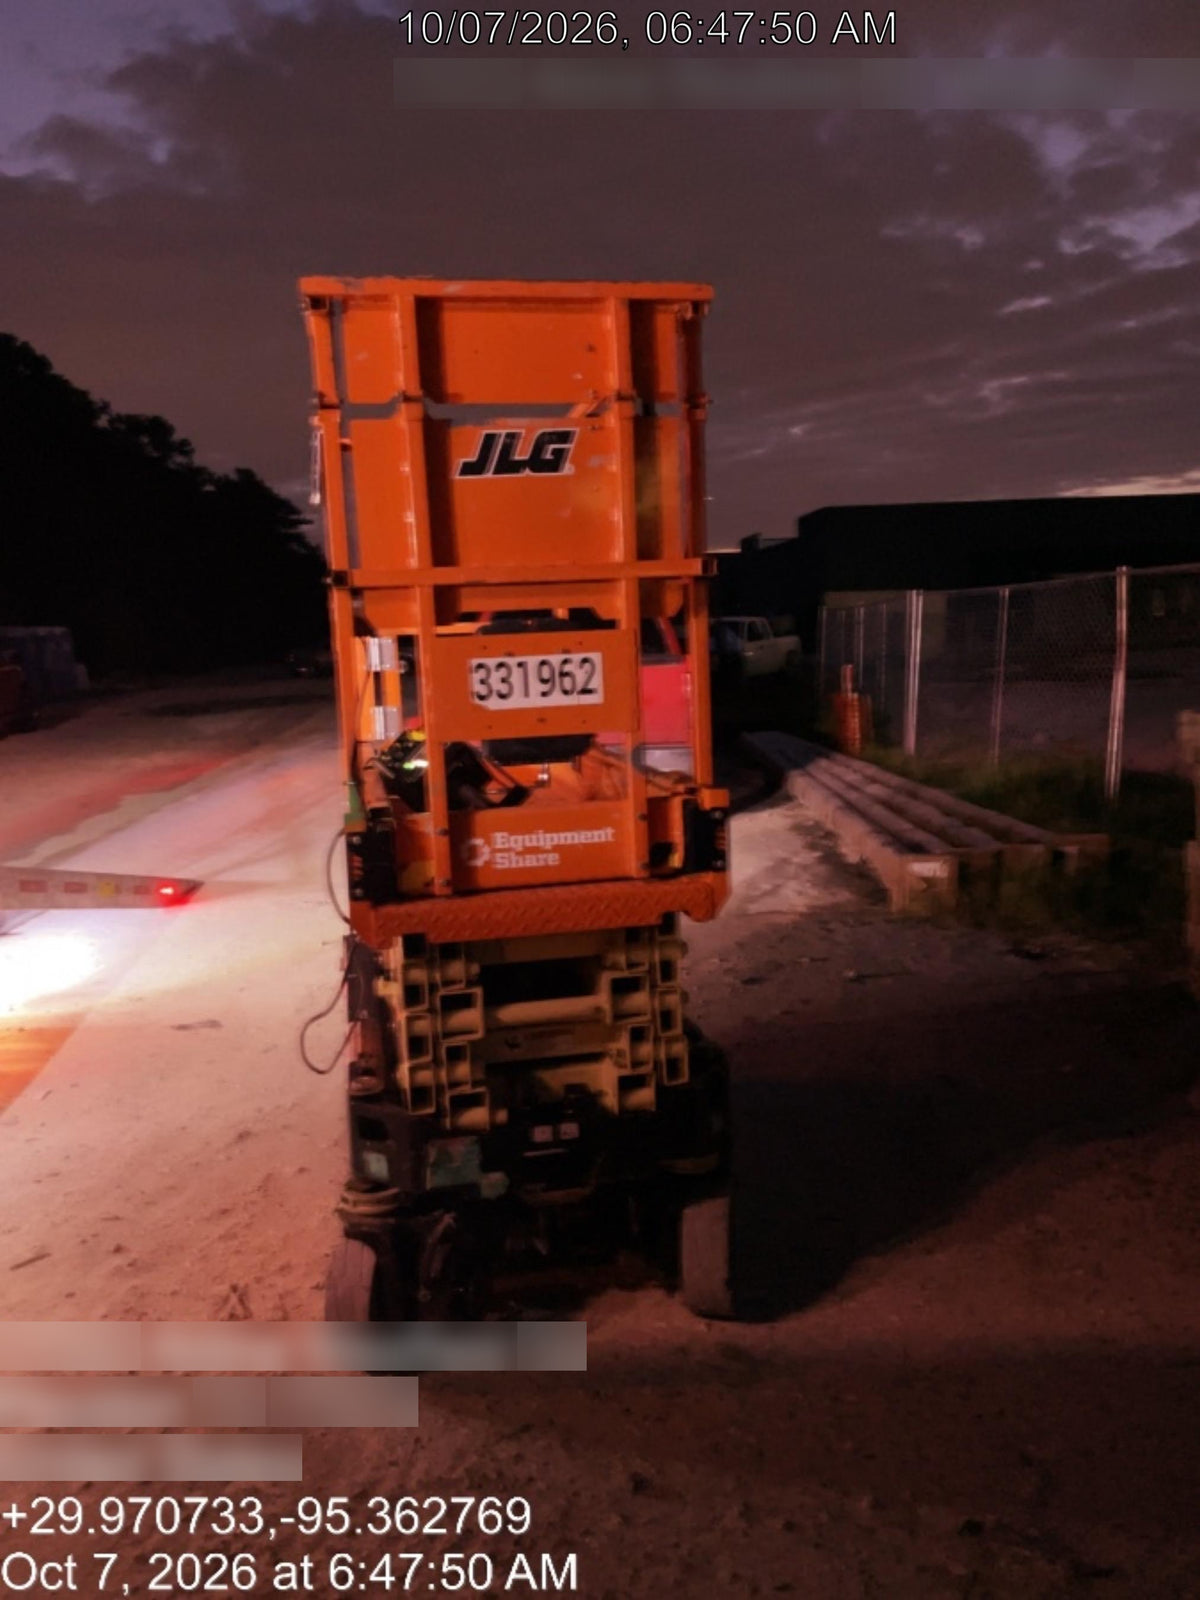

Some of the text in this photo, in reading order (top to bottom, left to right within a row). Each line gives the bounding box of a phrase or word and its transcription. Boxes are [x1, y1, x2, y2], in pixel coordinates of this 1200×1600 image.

[455, 427, 579, 478] JLG
[474, 657, 597, 701] 331962
[492, 827, 615, 851] Equipment
[493, 852, 560, 869] Share
